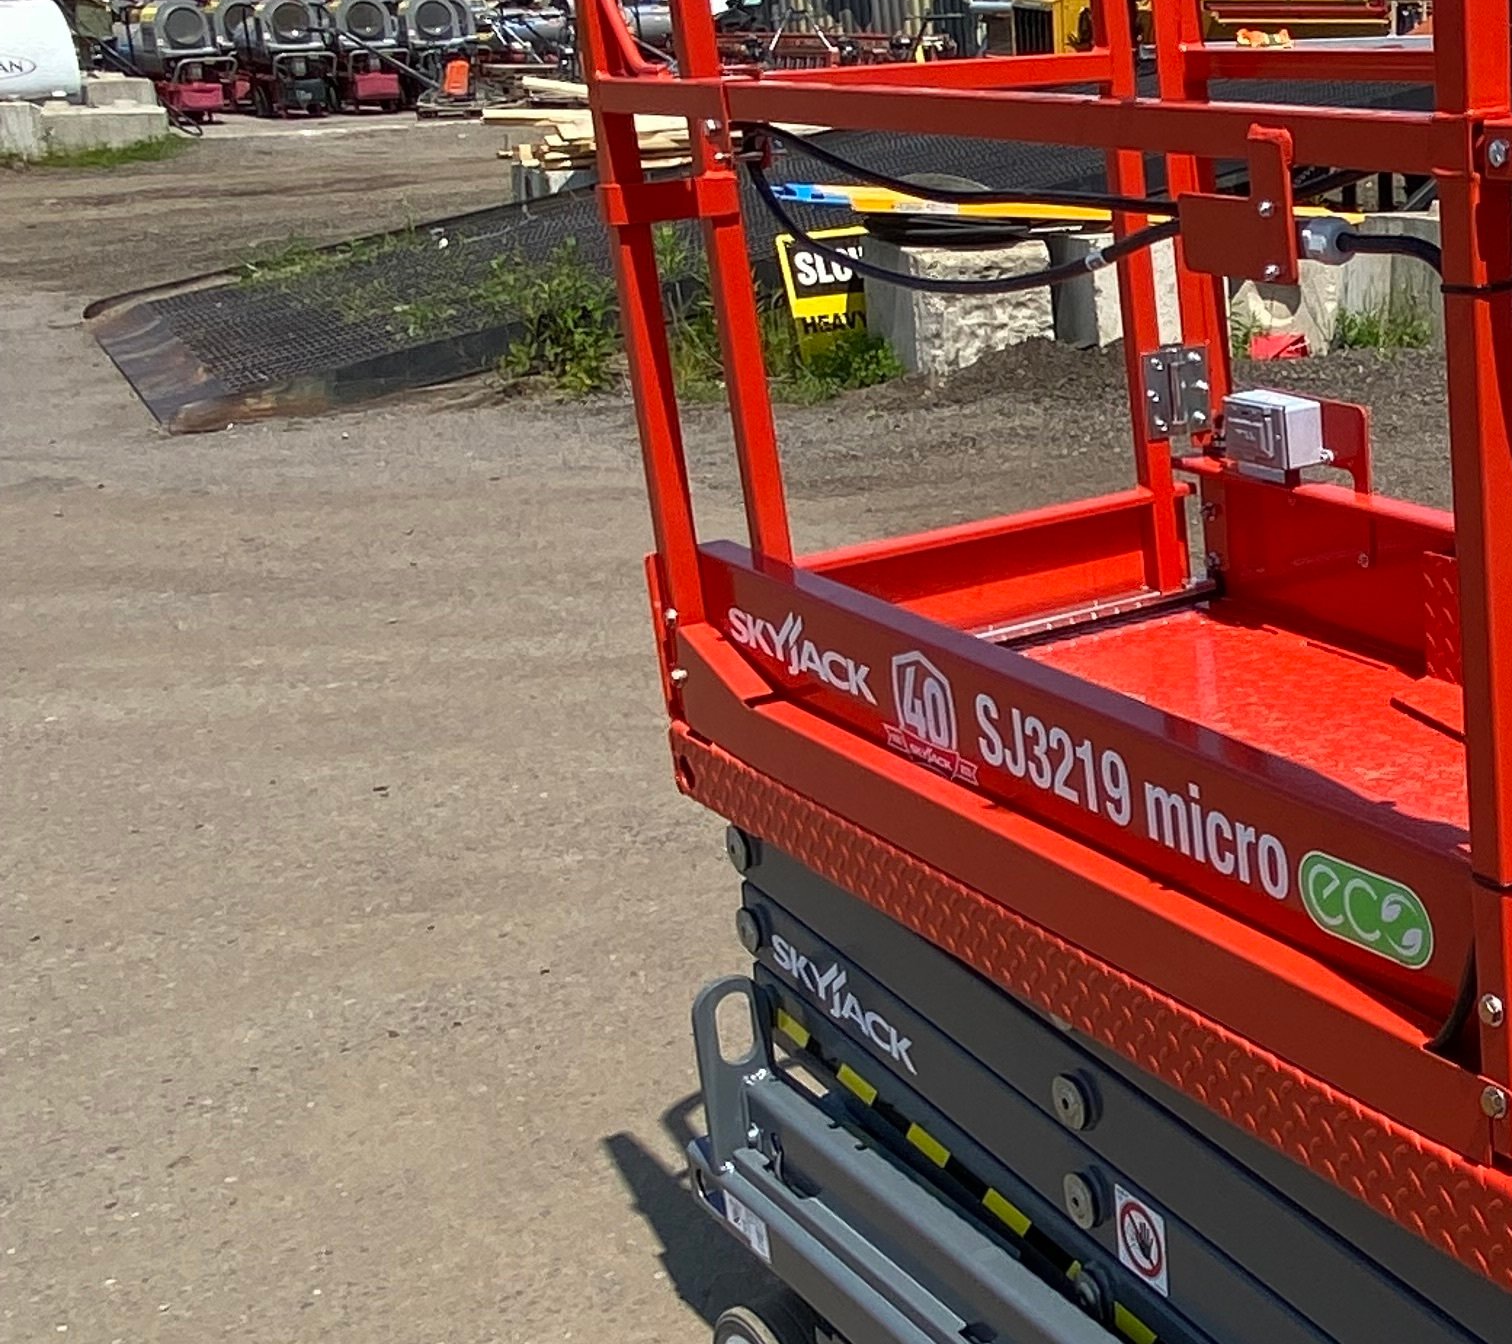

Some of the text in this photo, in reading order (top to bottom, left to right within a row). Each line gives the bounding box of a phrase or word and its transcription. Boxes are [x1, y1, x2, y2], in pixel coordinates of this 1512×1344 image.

[728, 607, 878, 706] SKYJACK
[902, 665, 950, 748] 40
[975, 692, 1289, 900] SJ3219 micro
[1308, 863, 1424, 957] eco
[771, 934, 918, 1076] SKYJACK
